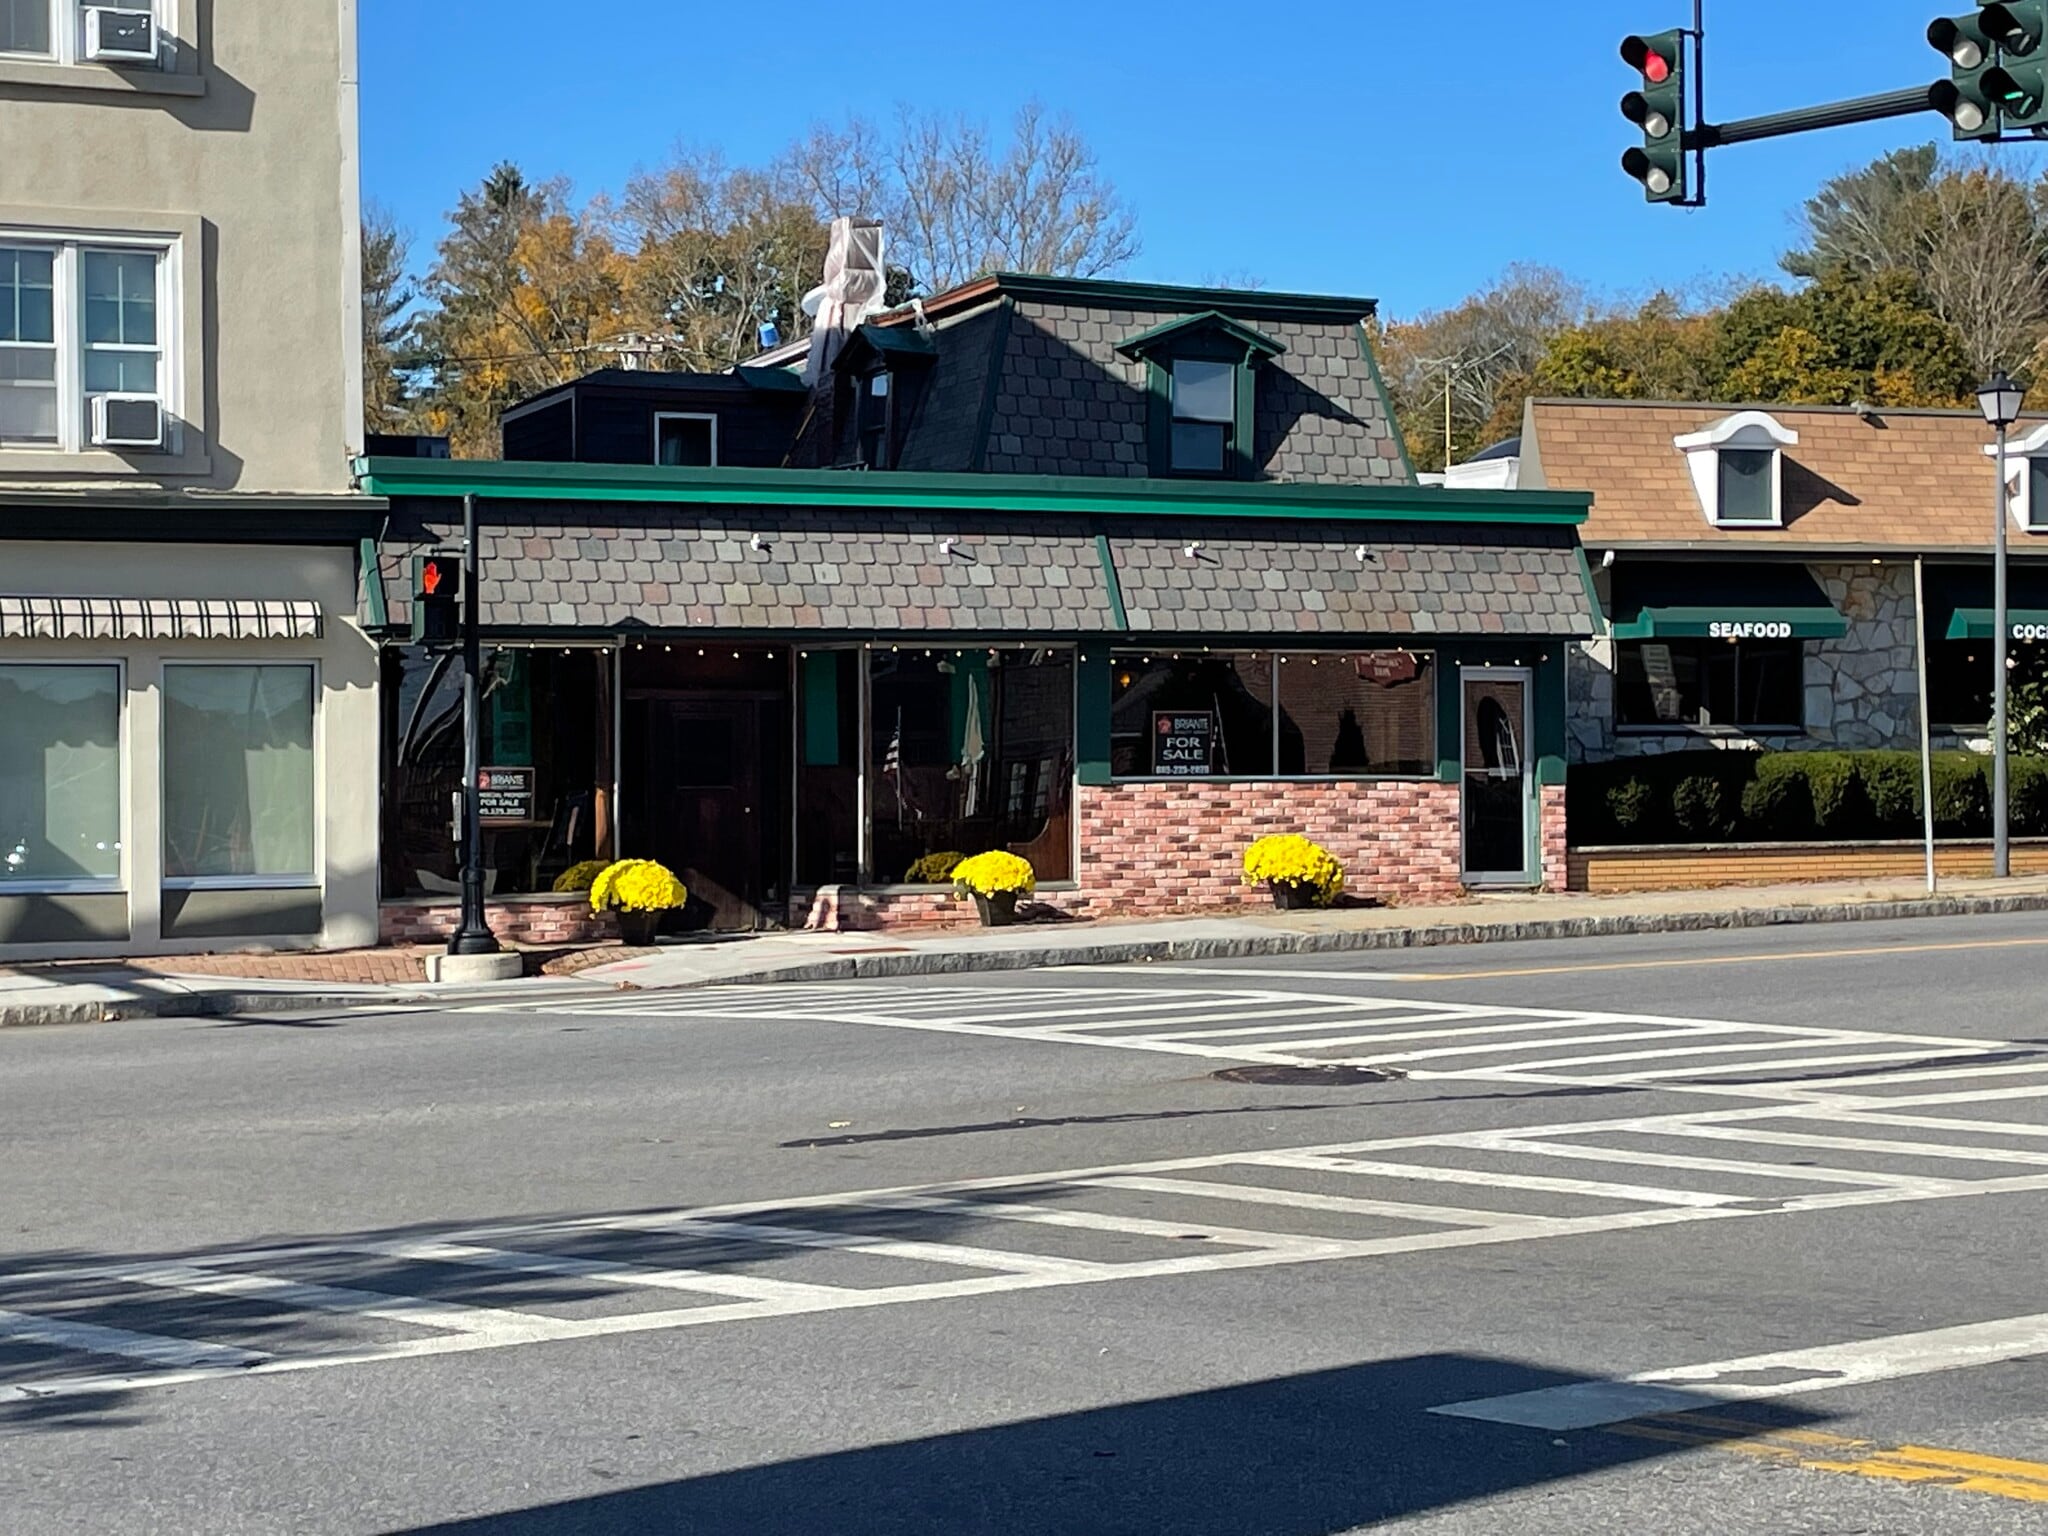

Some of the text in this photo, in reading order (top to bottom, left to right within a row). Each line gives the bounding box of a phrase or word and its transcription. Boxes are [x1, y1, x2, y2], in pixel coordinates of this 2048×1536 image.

[1708, 622, 1791, 638] SEAFOOD
[2012, 624, 2048, 639] COC
[1174, 718, 1208, 729] BRIANTE
[1166, 737, 1201, 748] FOR
[1162, 749, 1204, 760] SALE
